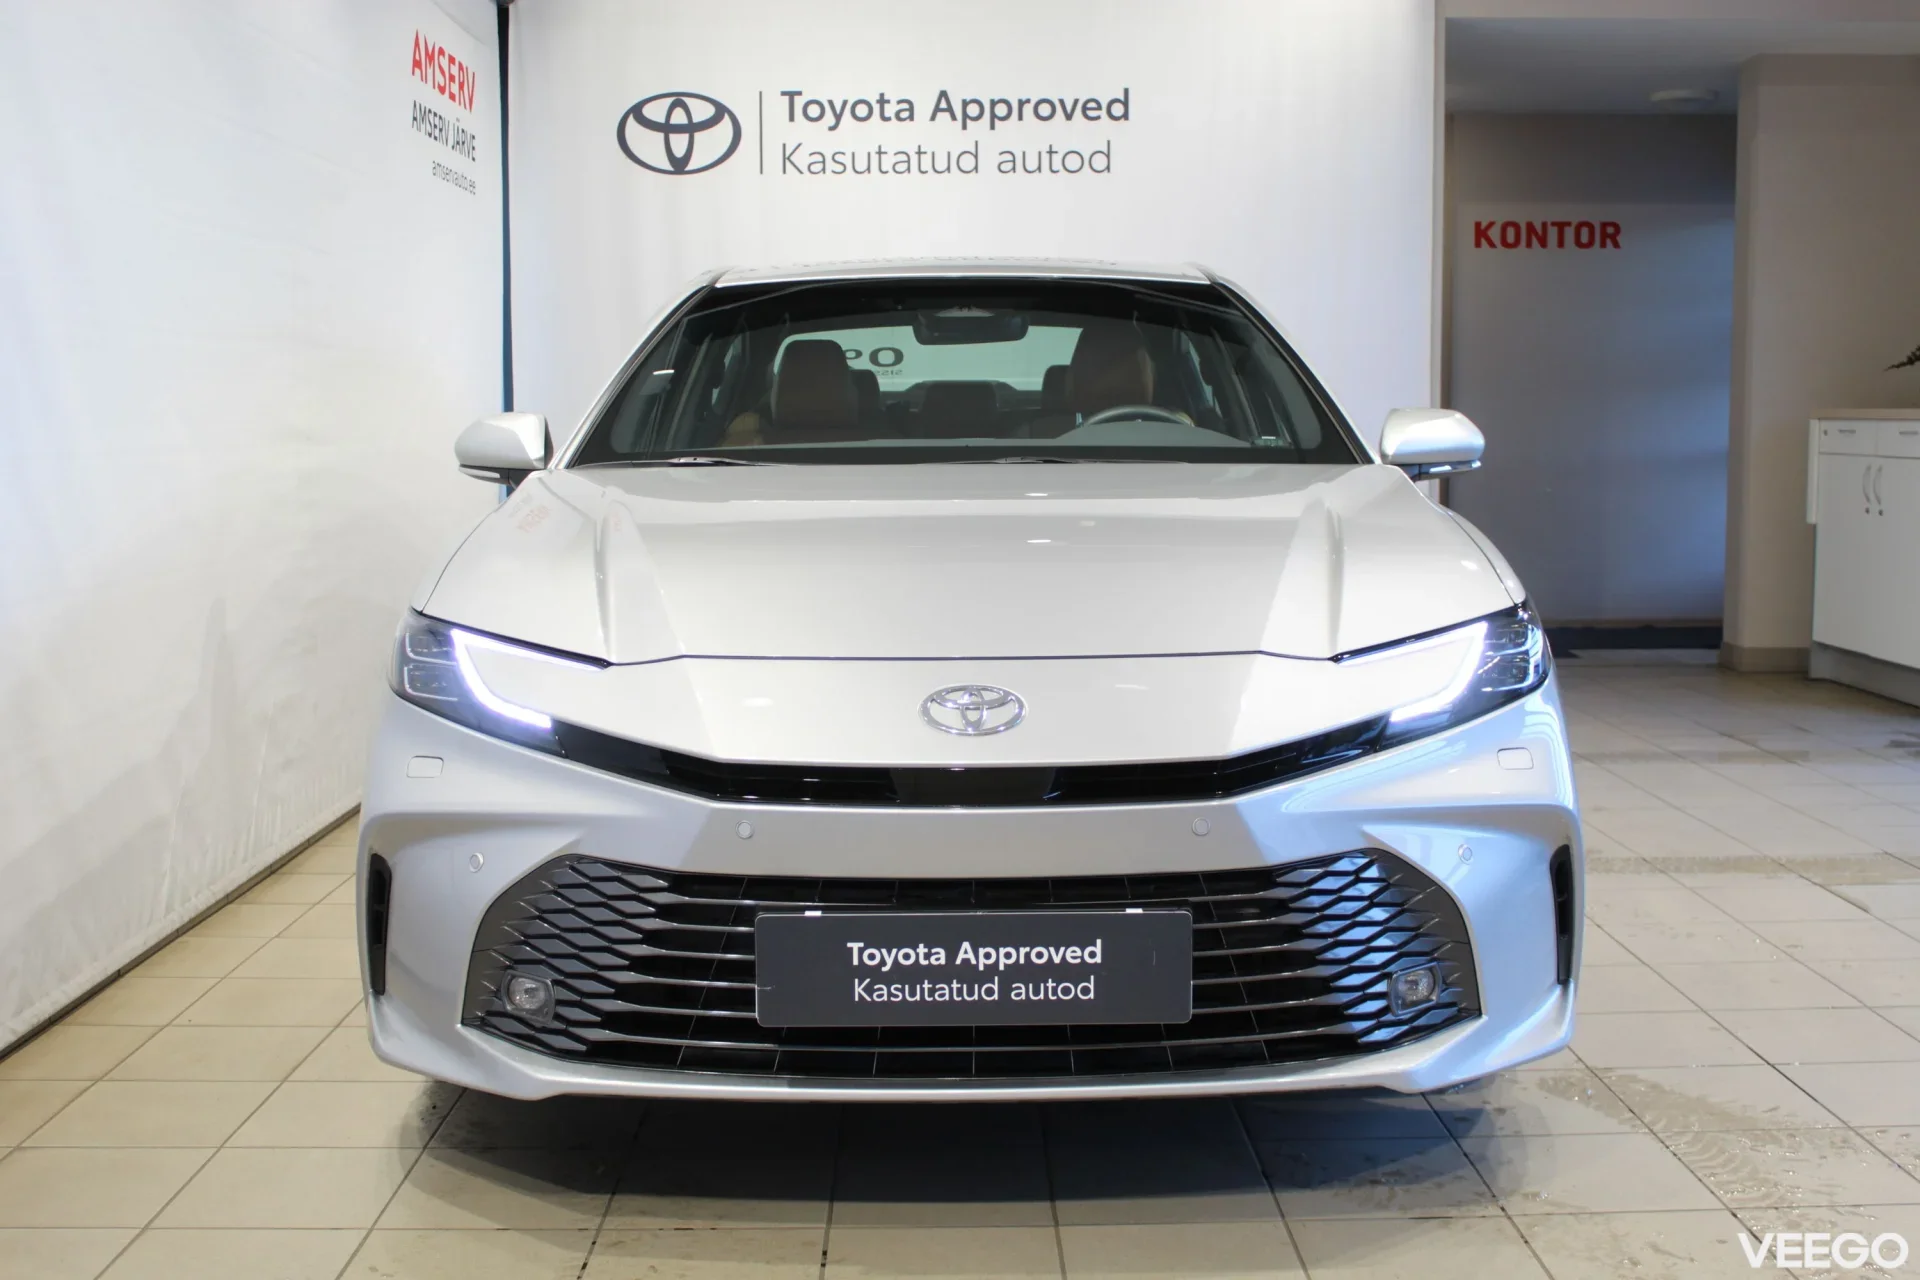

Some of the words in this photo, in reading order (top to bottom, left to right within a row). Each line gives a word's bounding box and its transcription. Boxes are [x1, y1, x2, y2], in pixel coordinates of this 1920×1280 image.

[411, 29, 476, 113] AMSERV
[780, 90, 915, 131] Toyota
[929, 87, 1131, 131] Approved
[411, 99, 451, 147] AMSERV
[451, 117, 476, 162] JÄRVE
[781, 140, 979, 175] Kasutatud
[996, 139, 1112, 174] autod
[432, 160, 476, 196] amservauto.ee
[1473, 221, 1621, 250] KONTOR
[846, 942, 946, 972] Toyota
[955, 938, 1102, 971] Approved
[853, 975, 999, 1002] Kasutatud
[1010, 975, 1095, 1001] autod
